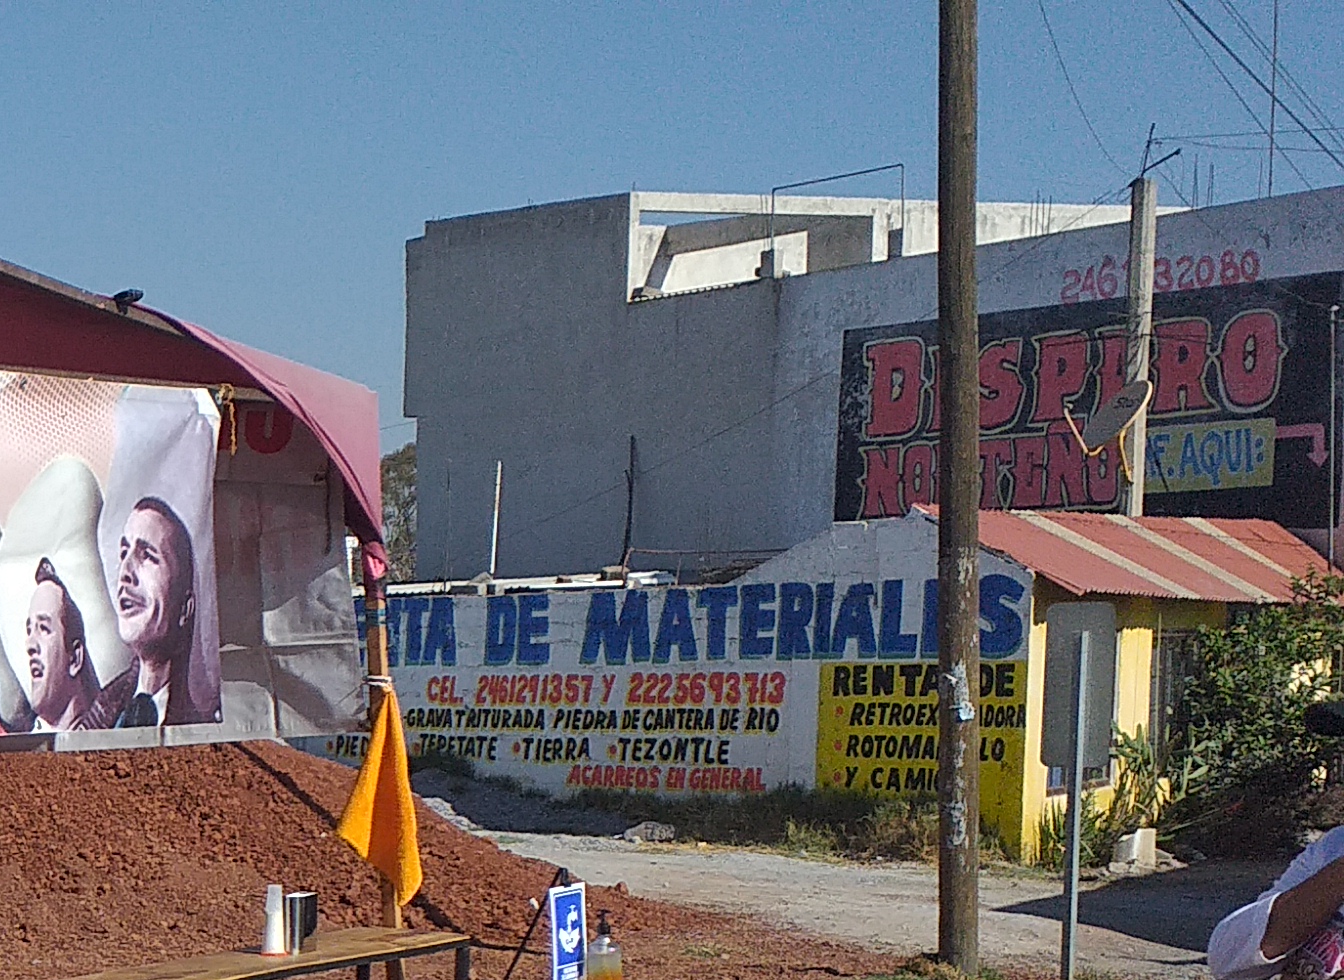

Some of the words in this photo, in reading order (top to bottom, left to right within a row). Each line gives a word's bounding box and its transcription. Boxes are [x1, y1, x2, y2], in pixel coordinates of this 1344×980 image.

[858, 418, 1122, 520] NOTEÑO
[484, 592, 551, 667] DE
[427, 675, 464, 704] CEL.
[601, 674, 616, 704] Y
[832, 664, 939, 698] RENTA
[979, 663, 1016, 698] DE
[455, 707, 546, 731] TRITURADA
[553, 707, 618, 731] PIEDRA
[621, 707, 641, 731] DE
[642, 707, 715, 732] CANTERA
[718, 707, 741, 731] DE
[744, 706, 781, 733] RIO
[419, 733, 498, 761] TEPETATE
[523, 736, 592, 762] TIERRA
[617, 736, 731, 765] TEZONTLE
[566, 764, 662, 790] ACARREOS
[666, 766, 688, 790] EN
[689, 766, 767, 792] GENERAL
[844, 766, 859, 788] Y
